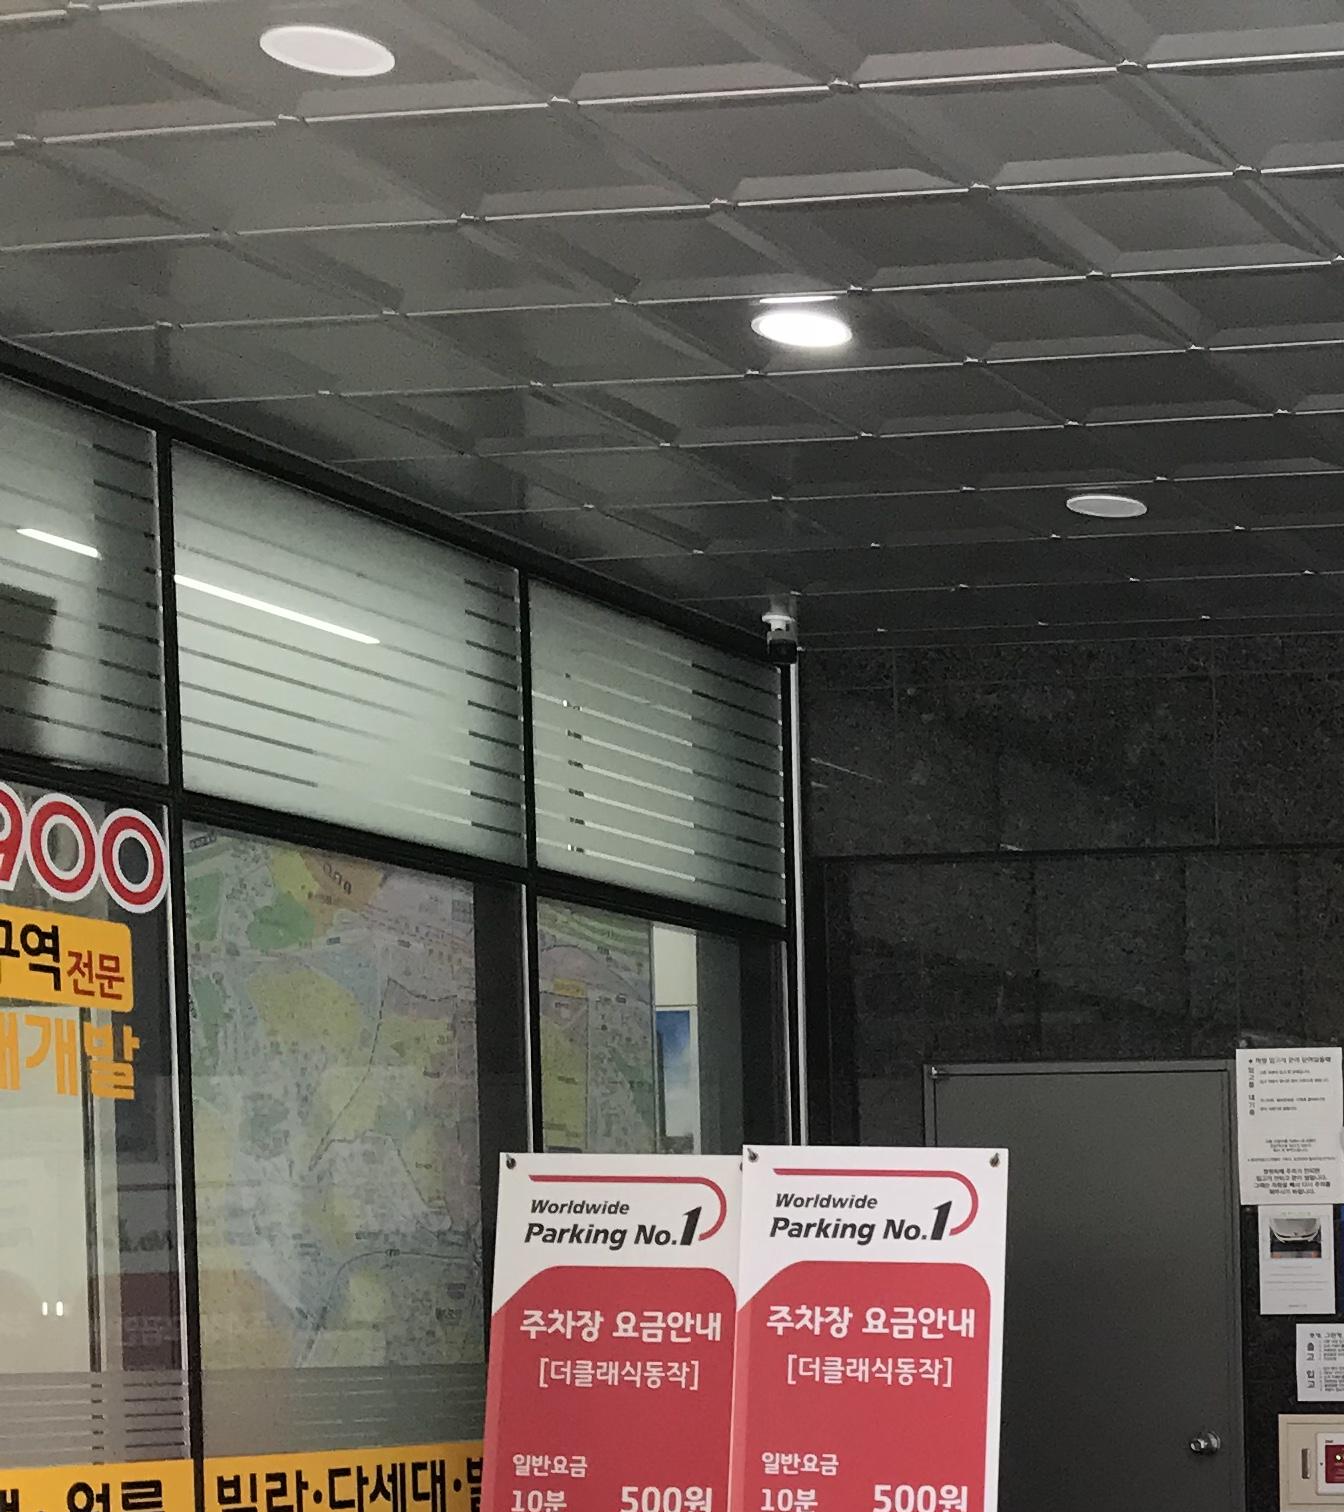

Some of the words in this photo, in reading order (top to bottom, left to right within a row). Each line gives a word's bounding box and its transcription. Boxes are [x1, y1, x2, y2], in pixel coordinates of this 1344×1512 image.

[67, 949, 126, 1000] 전문
[529, 1199, 630, 1216] Worldwide
[775, 1193, 878, 1210] Worldwide
[524, 1222, 627, 1251] Parking
[633, 1206, 704, 1247] No.1
[769, 1217, 873, 1245] Parking
[883, 1200, 953, 1241] No.1
[519, 1309, 602, 1343] 주차장
[612, 1310, 722, 1343] 요금안내
[766, 1305, 853, 1340] 주차장
[861, 1305, 976, 1340] 요금안내
[539, 1357, 700, 1391] [더클래식동작]
[787, 1354, 953, 1388] [더클래식동작]
[512, 1453, 588, 1478] 일반요금
[760, 1451, 840, 1477] 일반요금
